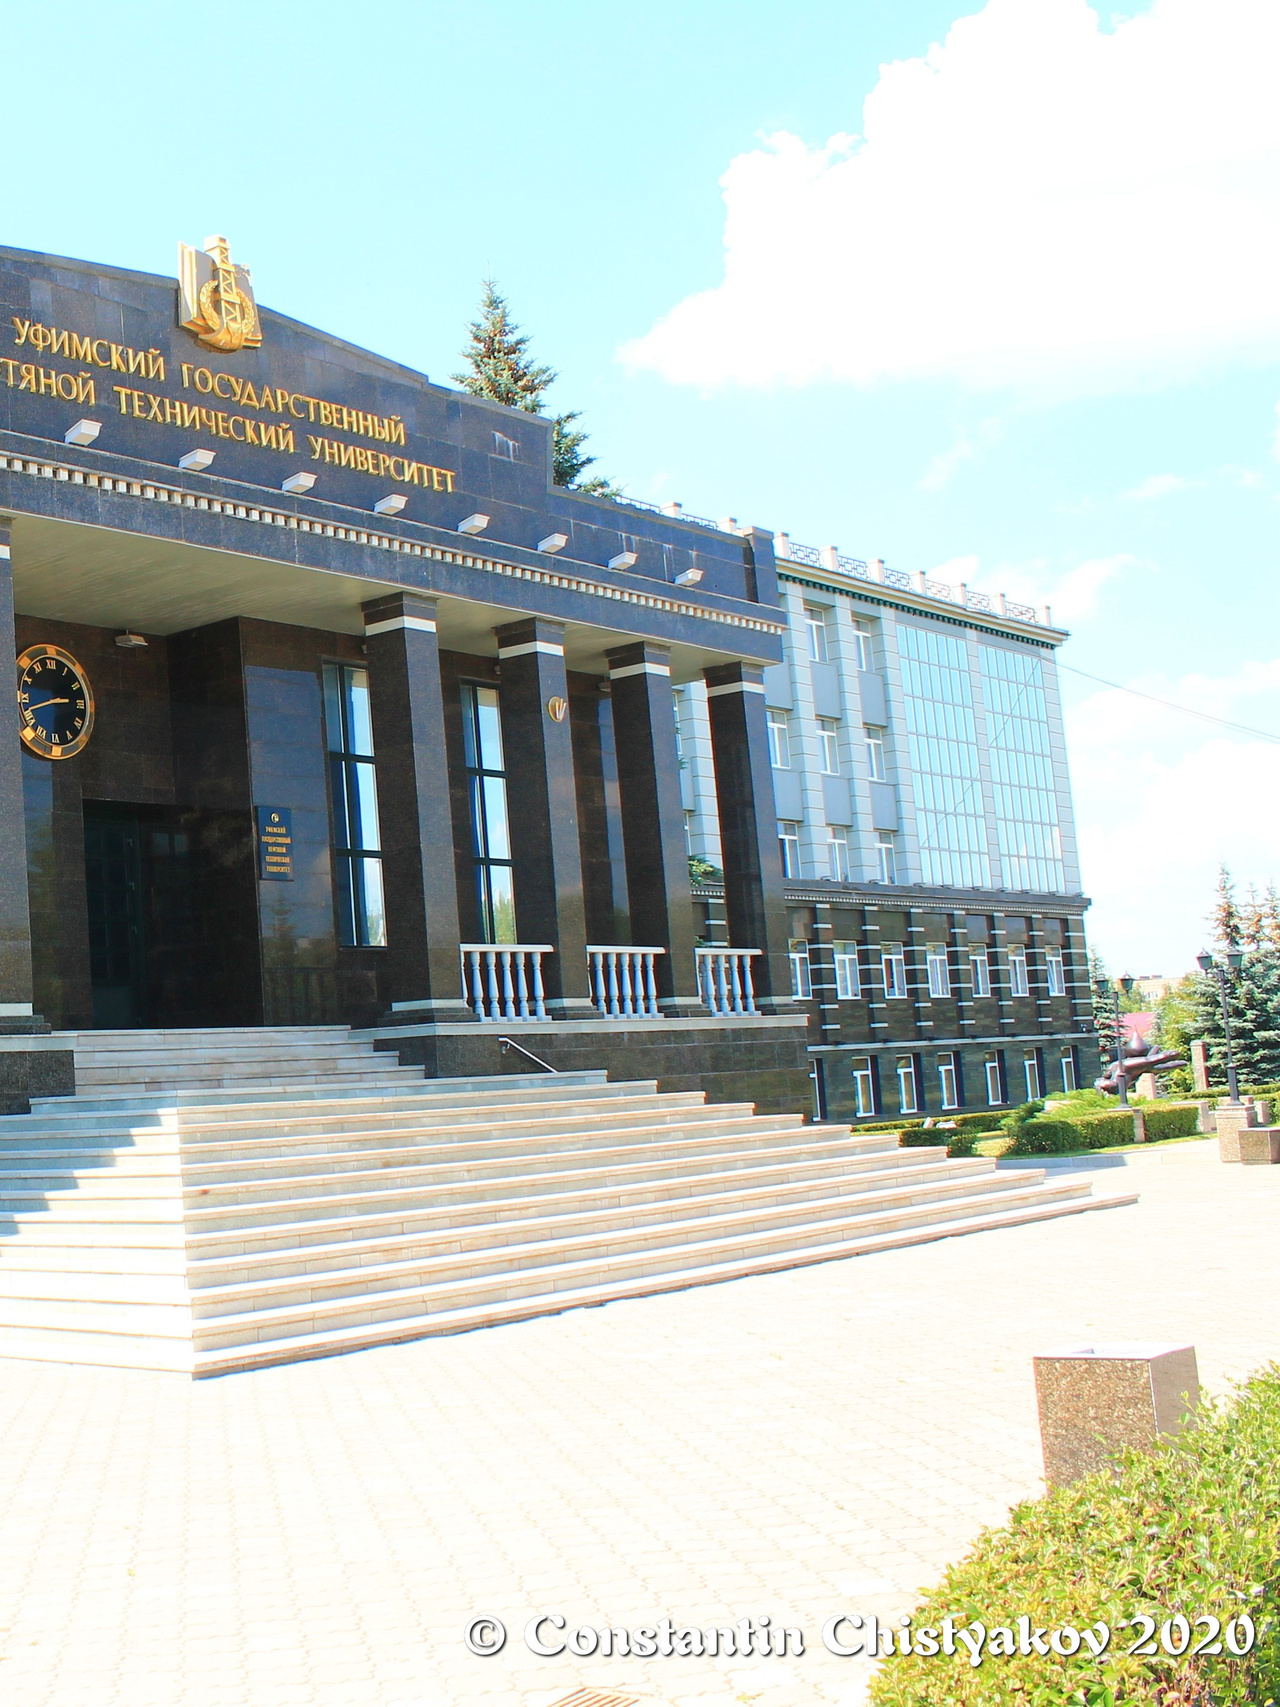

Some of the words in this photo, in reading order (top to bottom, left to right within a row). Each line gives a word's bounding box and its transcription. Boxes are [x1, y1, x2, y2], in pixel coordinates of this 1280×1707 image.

[11, 316, 166, 383] УФИМСКИЙ
[181, 362, 406, 447] ГОСУДАРСТВЕННЫЙ
[112, 386, 295, 454] ТЕХНИЧЕСКИЙ
[307, 434, 457, 494] УНИВЕРСИТЕТ
[33, 662, 43, 674] XI
[46, 659, 56, 670] XII
[24, 675, 32, 685] X
[76, 700, 85, 710] III
[36, 725, 48, 740] VII
[66, 730, 73, 741] V
